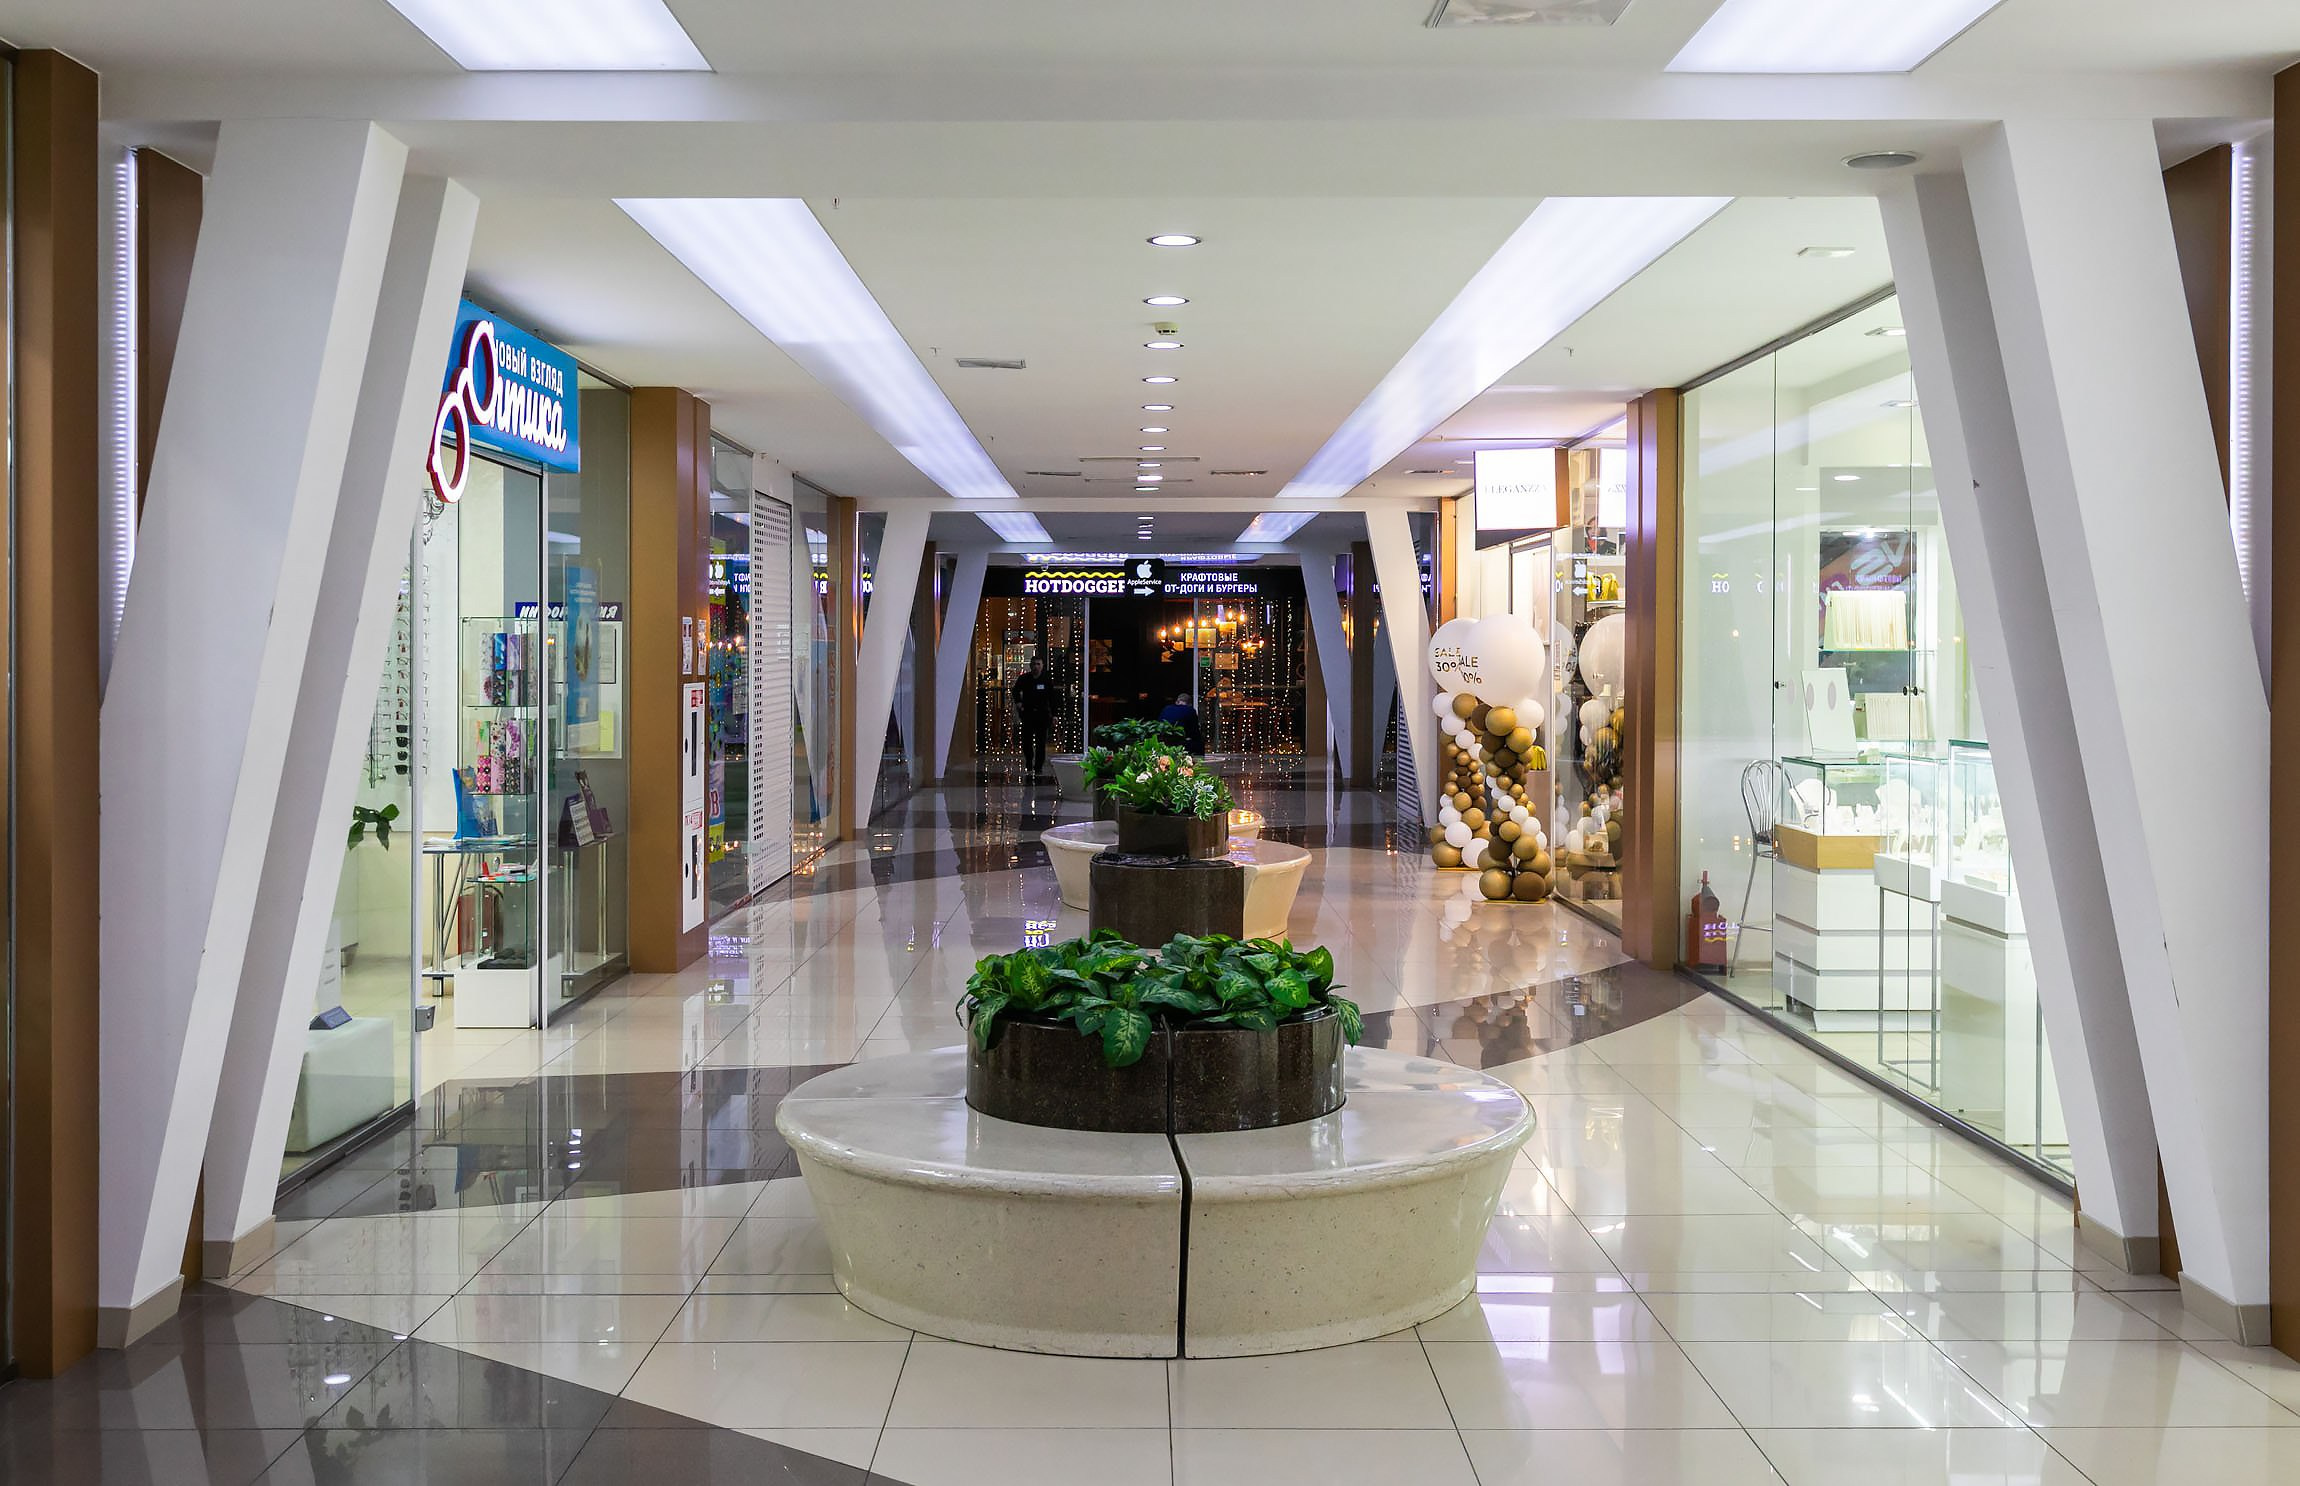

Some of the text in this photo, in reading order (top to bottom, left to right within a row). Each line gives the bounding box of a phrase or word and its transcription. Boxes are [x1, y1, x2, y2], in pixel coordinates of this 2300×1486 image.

[530, 356, 564, 399] ВЗГЛЯД
[1180, 572, 1238, 582] КРАФТОВЫЕ
[1164, 583, 1258, 594] ОТ-ДОГИ И БУРГЕРЫ
[1434, 647, 1461, 658] SALE
[1458, 655, 1479, 668] ALE
[1461, 668, 1482, 684] 0%
